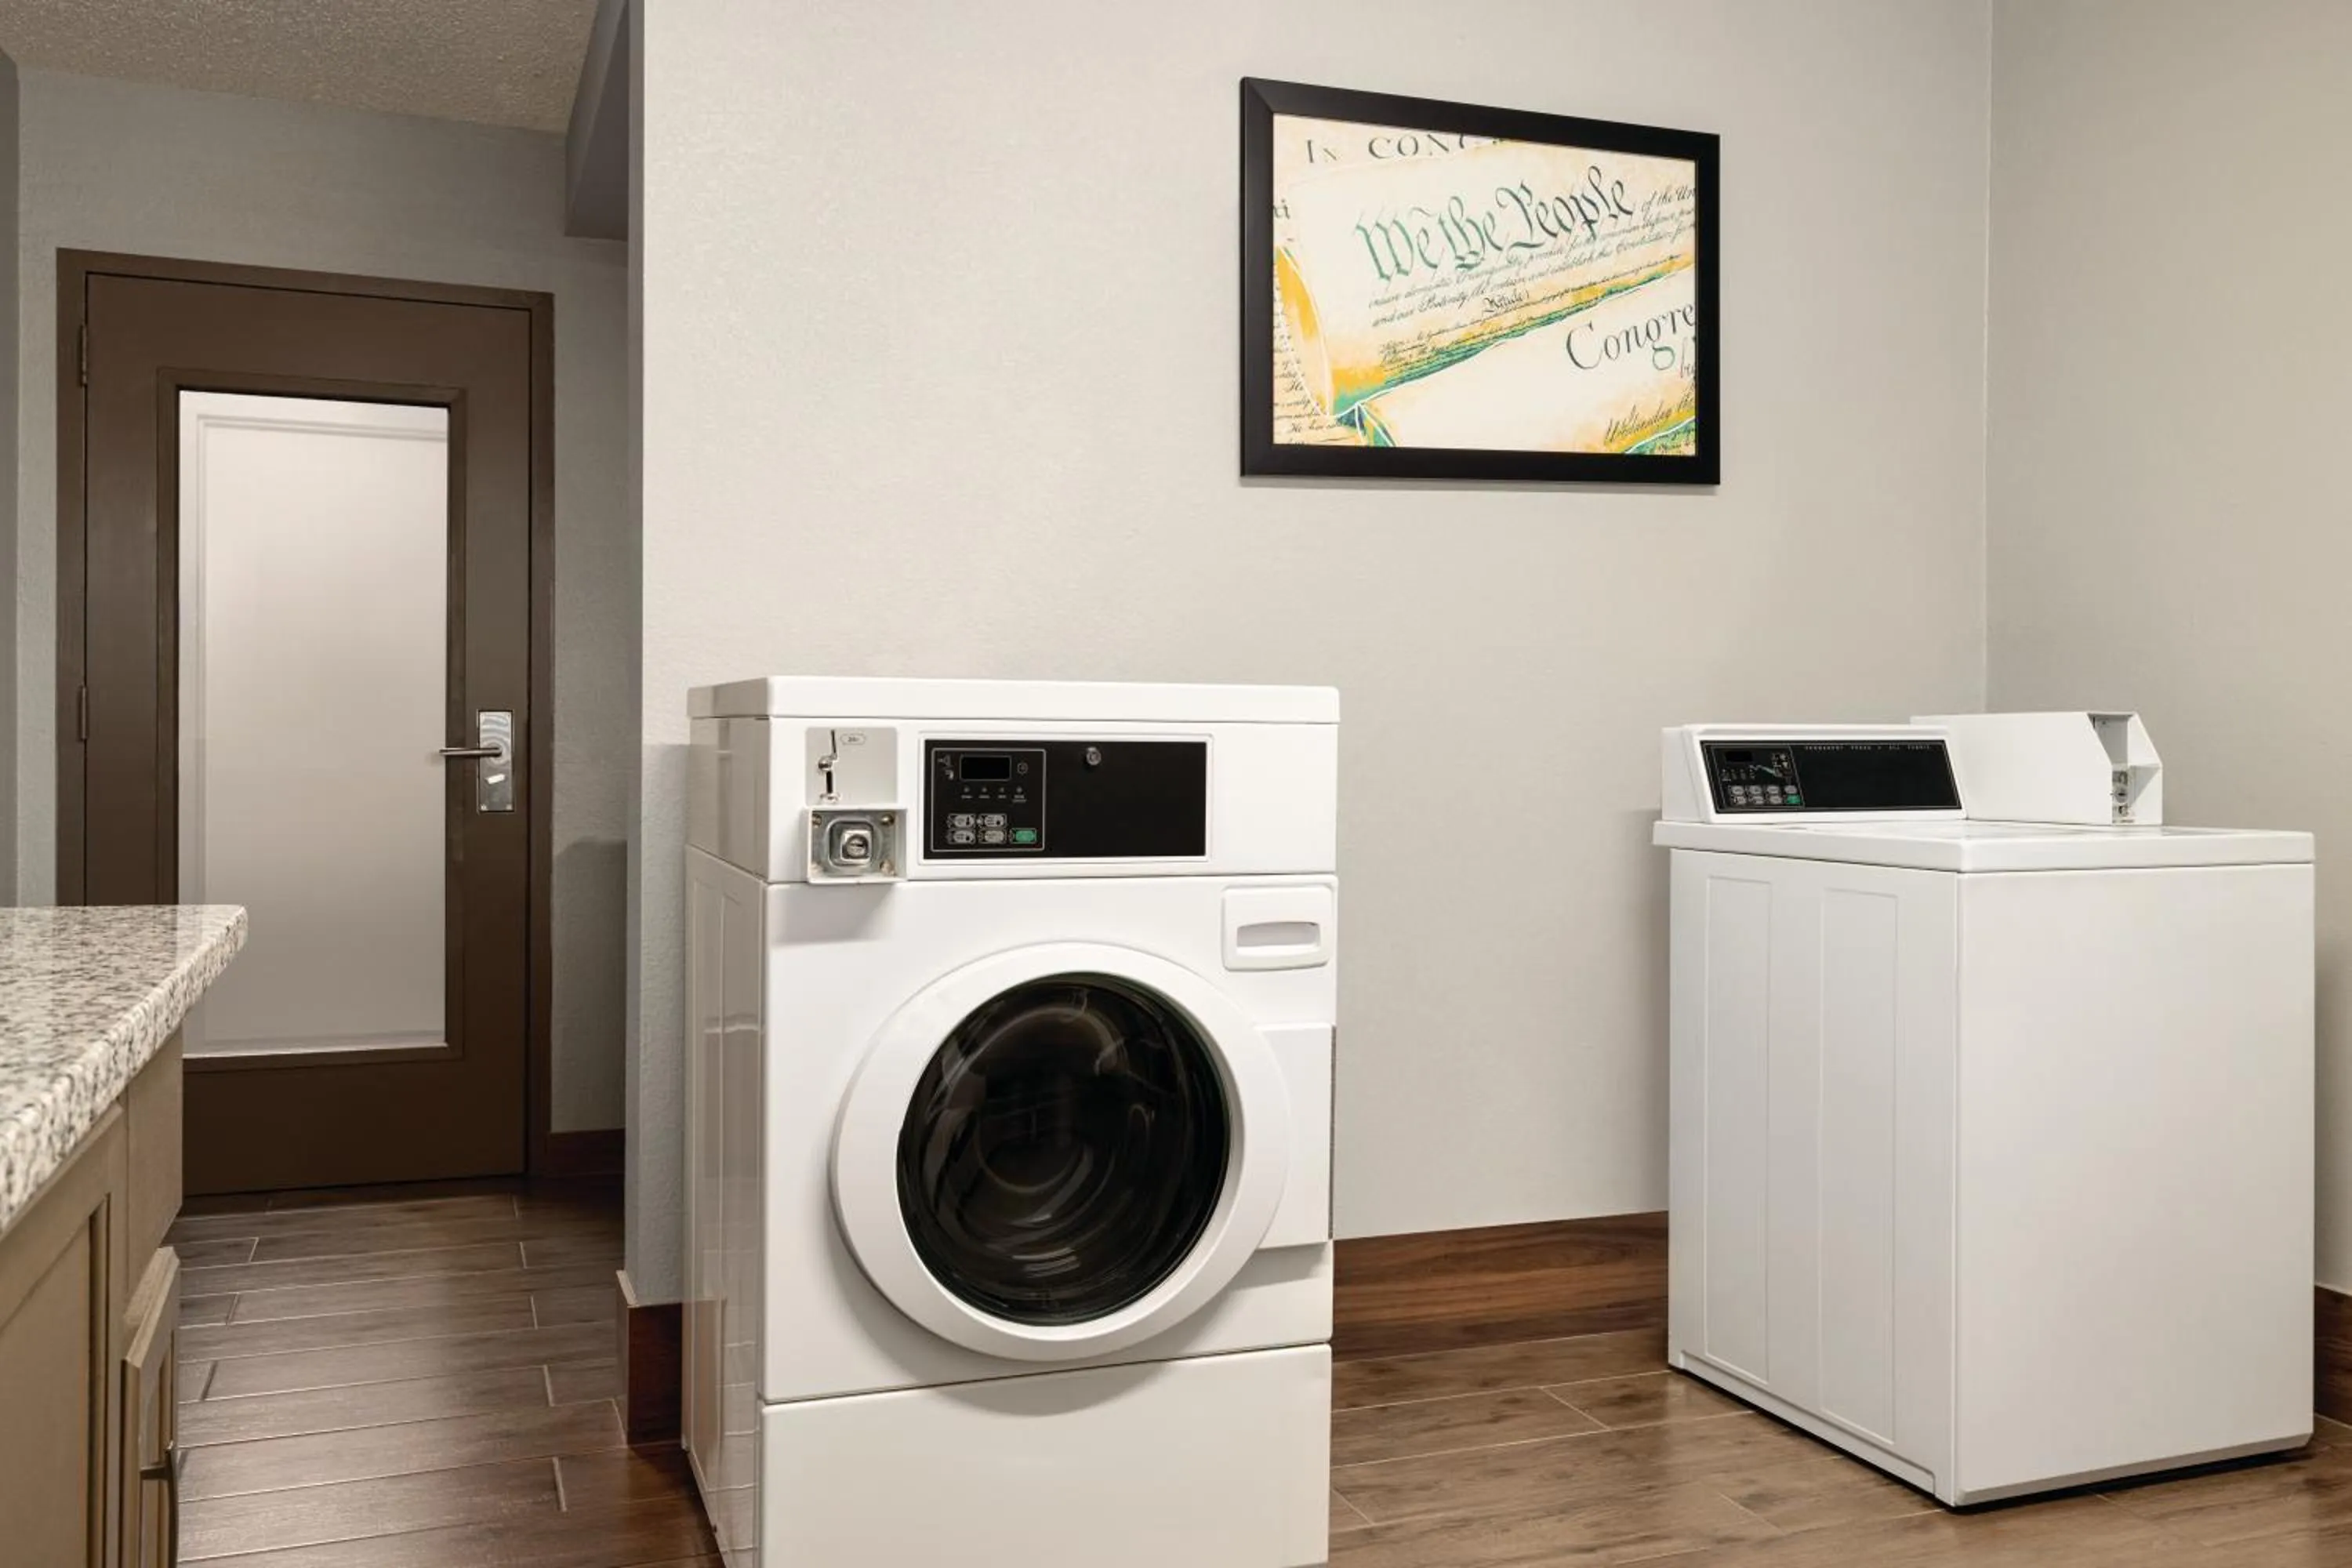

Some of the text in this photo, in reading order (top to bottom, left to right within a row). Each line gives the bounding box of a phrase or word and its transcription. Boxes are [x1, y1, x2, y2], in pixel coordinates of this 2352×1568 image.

[1355, 207, 1438, 282] We
[1438, 195, 1503, 270] the
[1495, 165, 1633, 249] People
[1566, 304, 1694, 371] Congre
